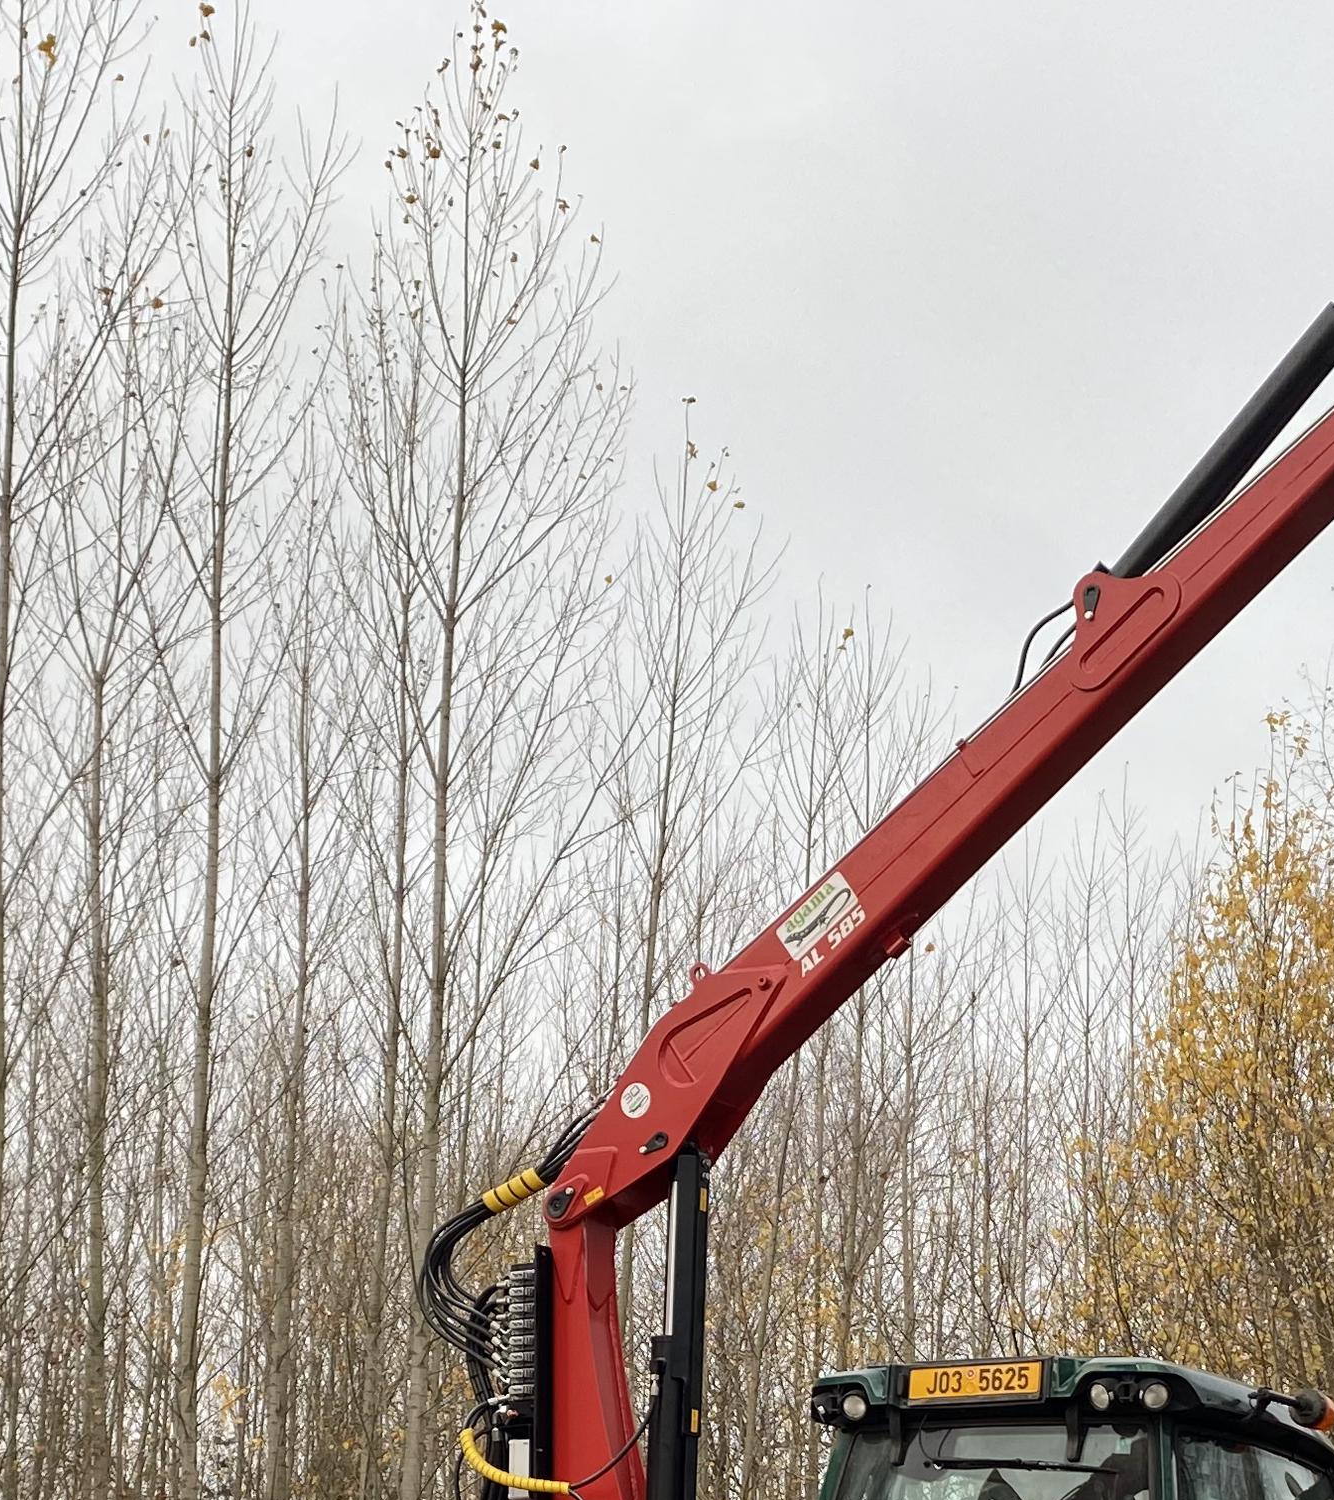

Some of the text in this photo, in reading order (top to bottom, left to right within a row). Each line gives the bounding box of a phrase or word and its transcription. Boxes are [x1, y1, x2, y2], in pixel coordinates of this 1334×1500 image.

[785, 883, 835, 933] agama
[800, 904, 866, 978] AL 585
[926, 1366, 1030, 1395] J03 5625
